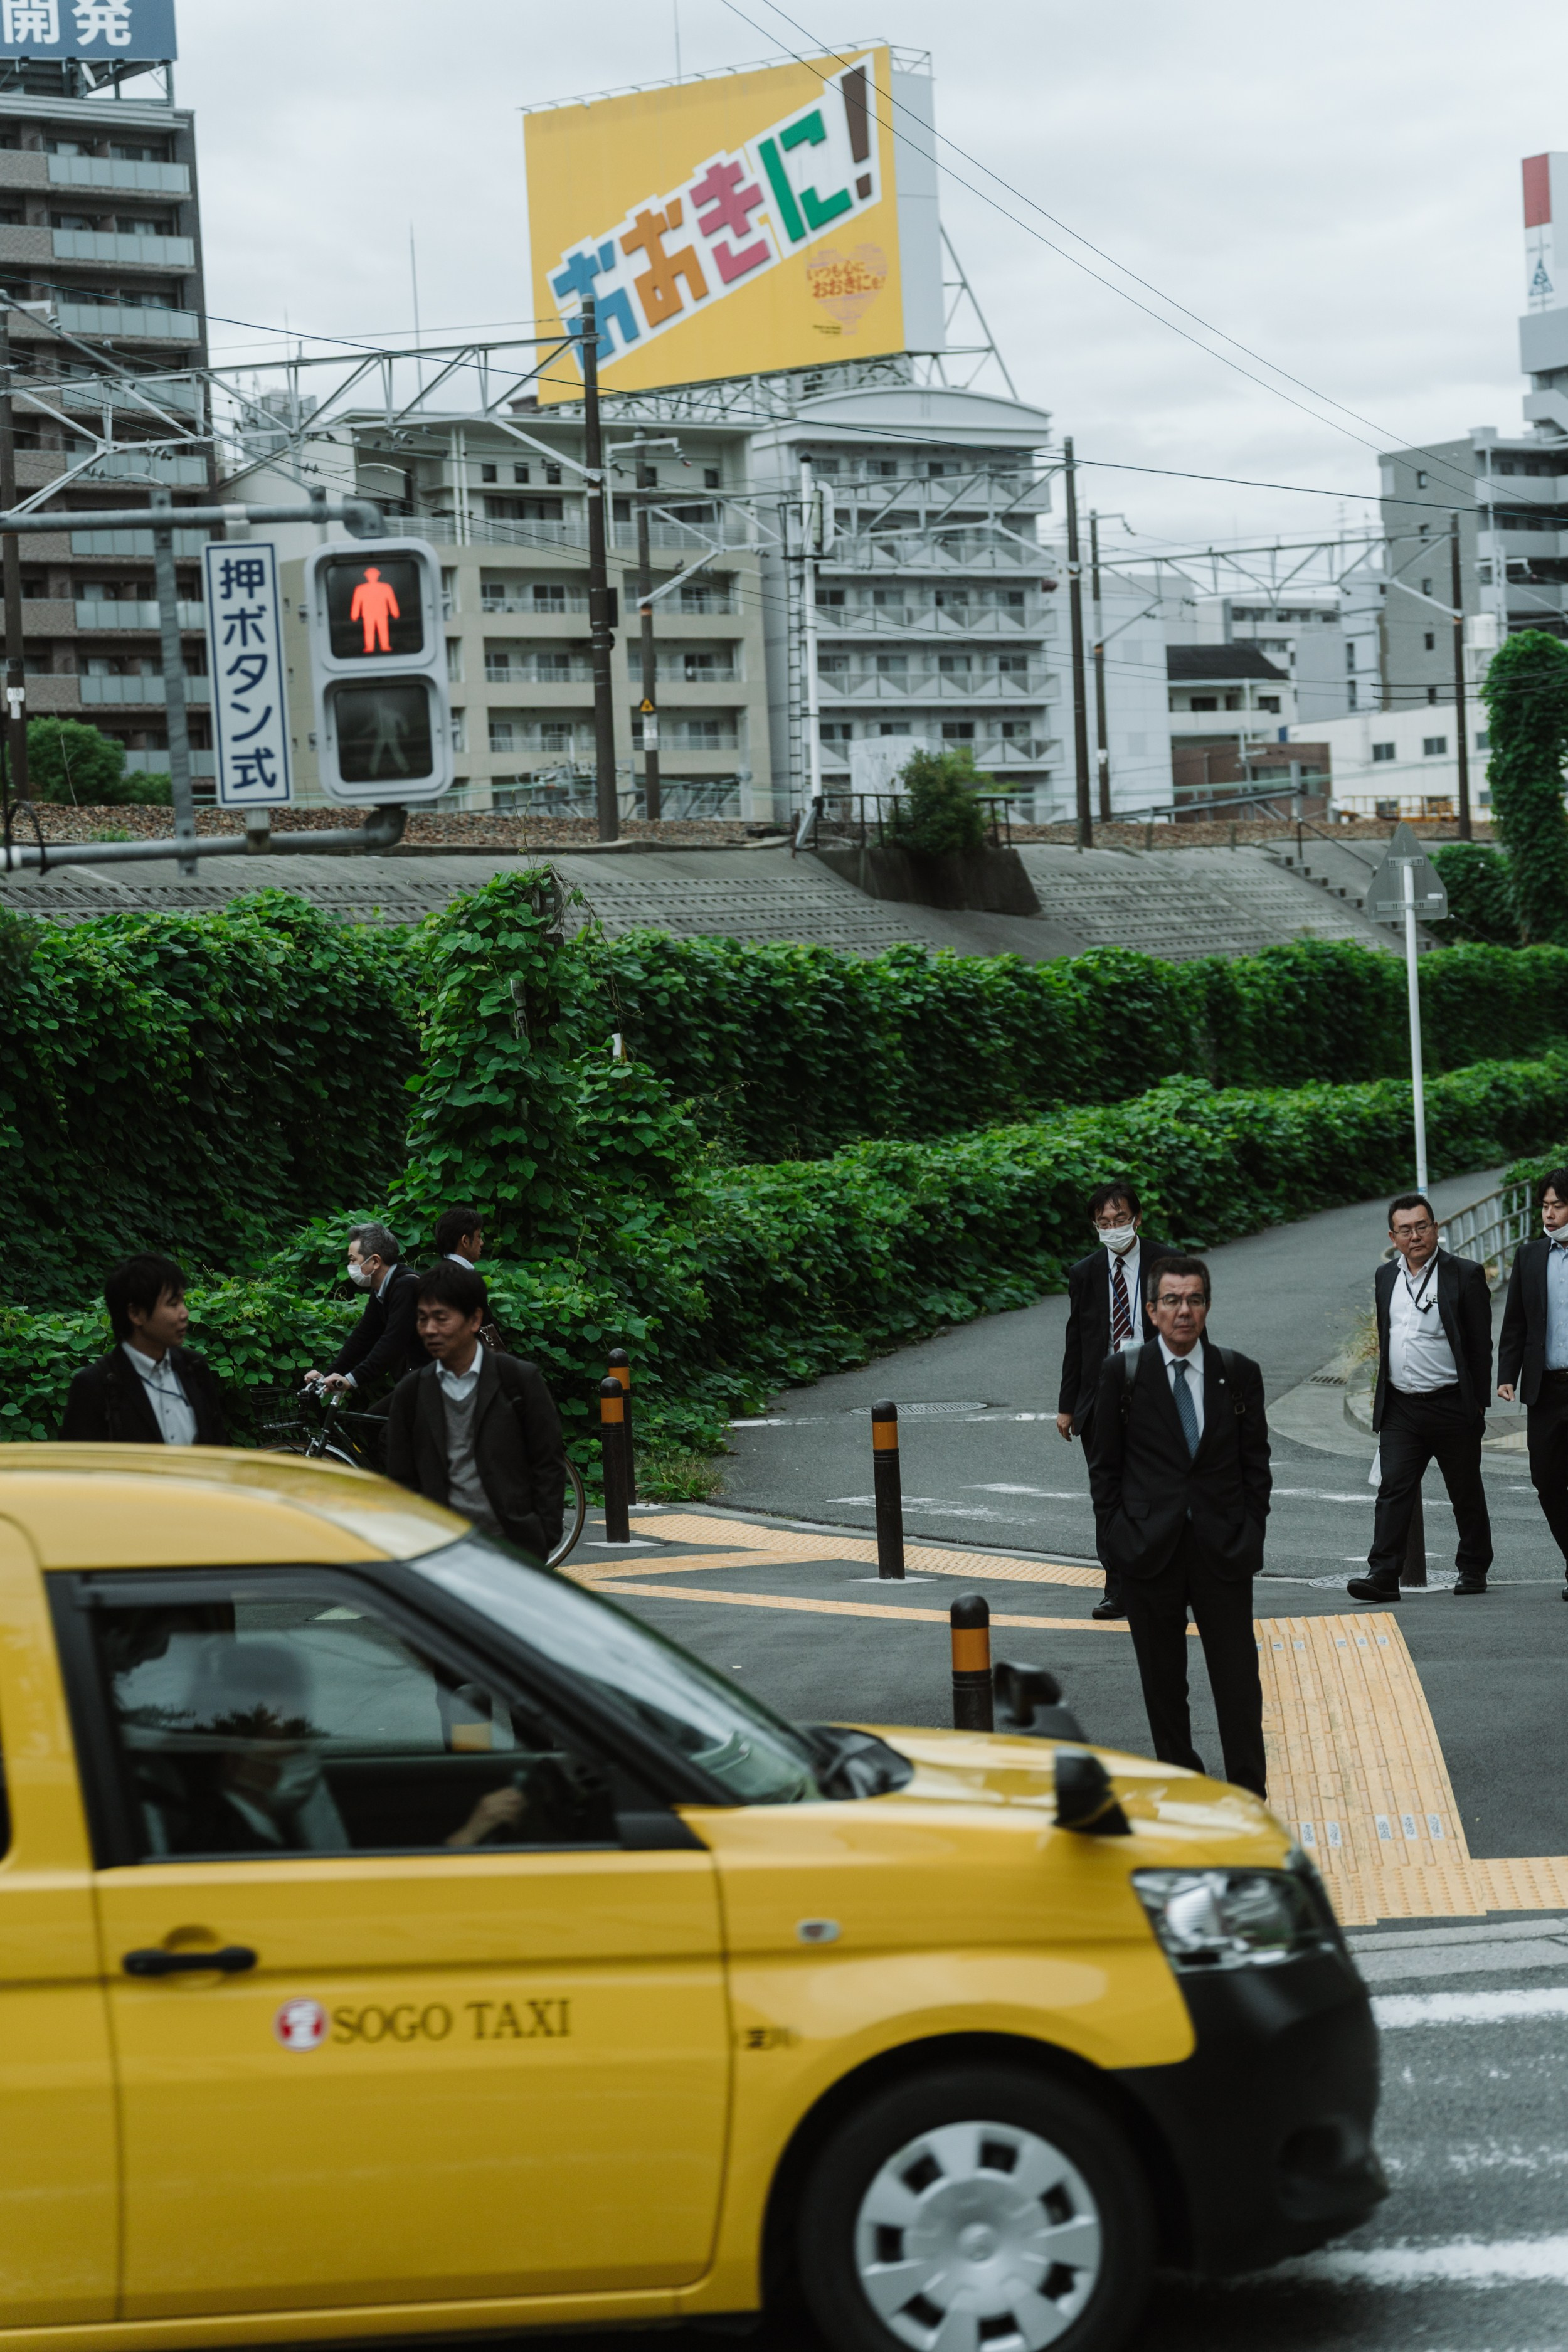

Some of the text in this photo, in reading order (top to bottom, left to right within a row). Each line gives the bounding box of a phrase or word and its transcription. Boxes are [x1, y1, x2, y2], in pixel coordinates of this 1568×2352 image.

[1, 0, 132, 46] 開発
[220, 558, 277, 789] 押ボタン式
[332, 1998, 571, 2045] SOGO TAXI
